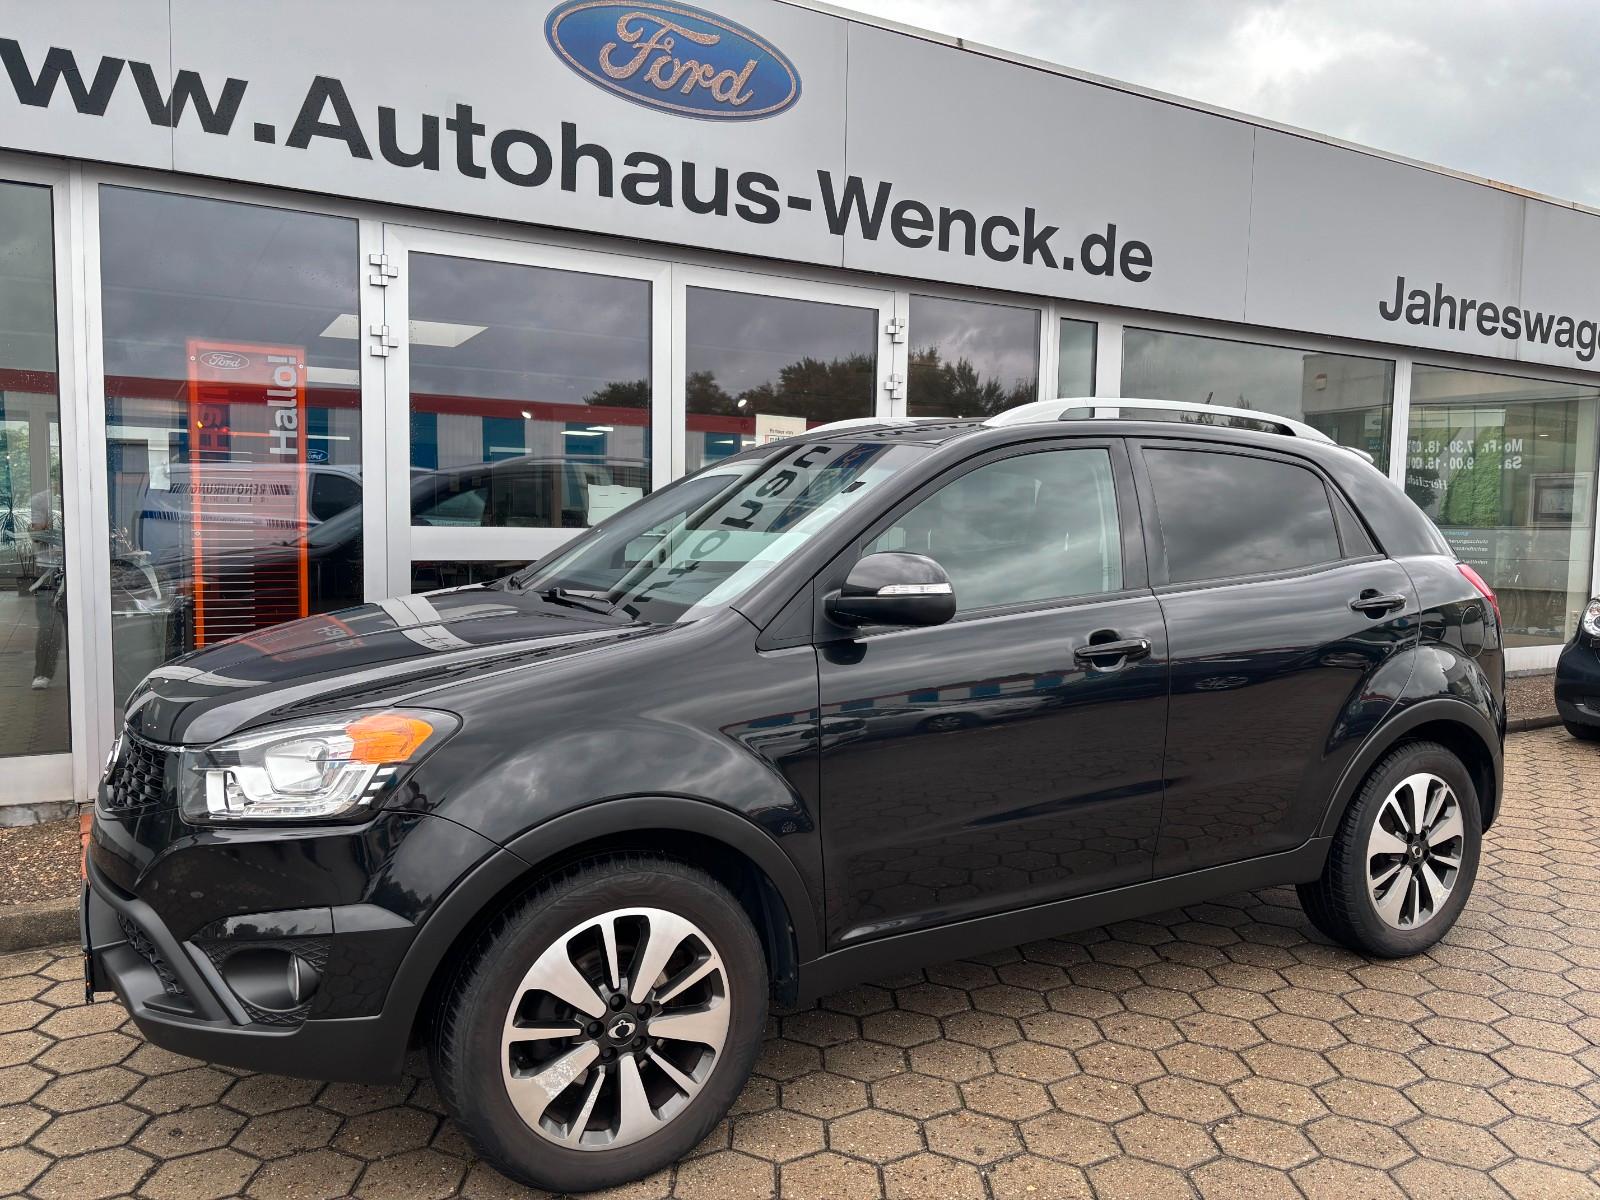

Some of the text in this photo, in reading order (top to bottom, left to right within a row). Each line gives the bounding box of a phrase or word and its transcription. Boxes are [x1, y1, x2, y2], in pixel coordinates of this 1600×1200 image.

[599, 11, 758, 106] Ford
[207, 352, 242, 368] Ford
[1378, 275, 1600, 362] Jahreswag
[266, 355, 298, 455] Hallo!
